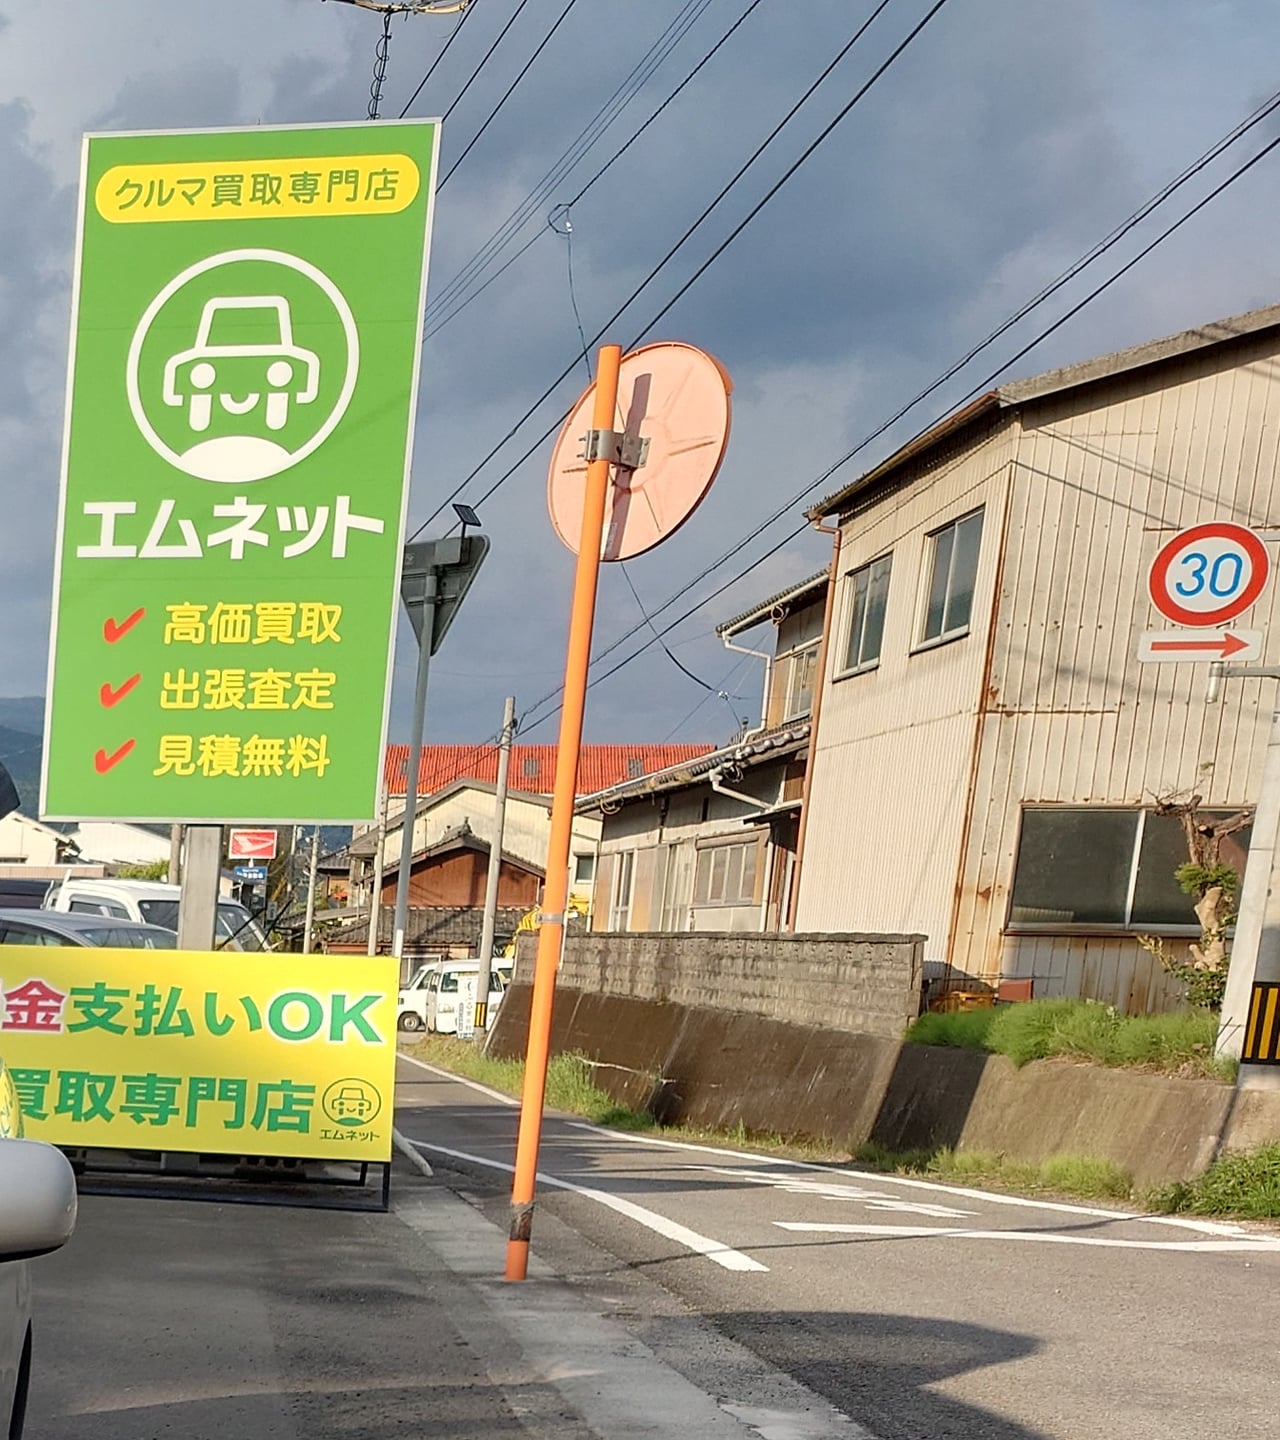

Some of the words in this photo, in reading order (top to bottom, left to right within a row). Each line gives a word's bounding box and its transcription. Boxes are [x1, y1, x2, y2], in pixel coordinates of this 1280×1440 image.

[114, 167, 401, 211] クルマ買取専門店
[76, 495, 385, 561] エムネット
[1175, 552, 1243, 598] 30
[163, 601, 343, 647] 高価買取
[158, 667, 338, 713] 出張査定
[151, 733, 332, 779] 見積無料
[7, 1066, 317, 1134] 買取専門店
[319, 1128, 381, 1142] エムネット
